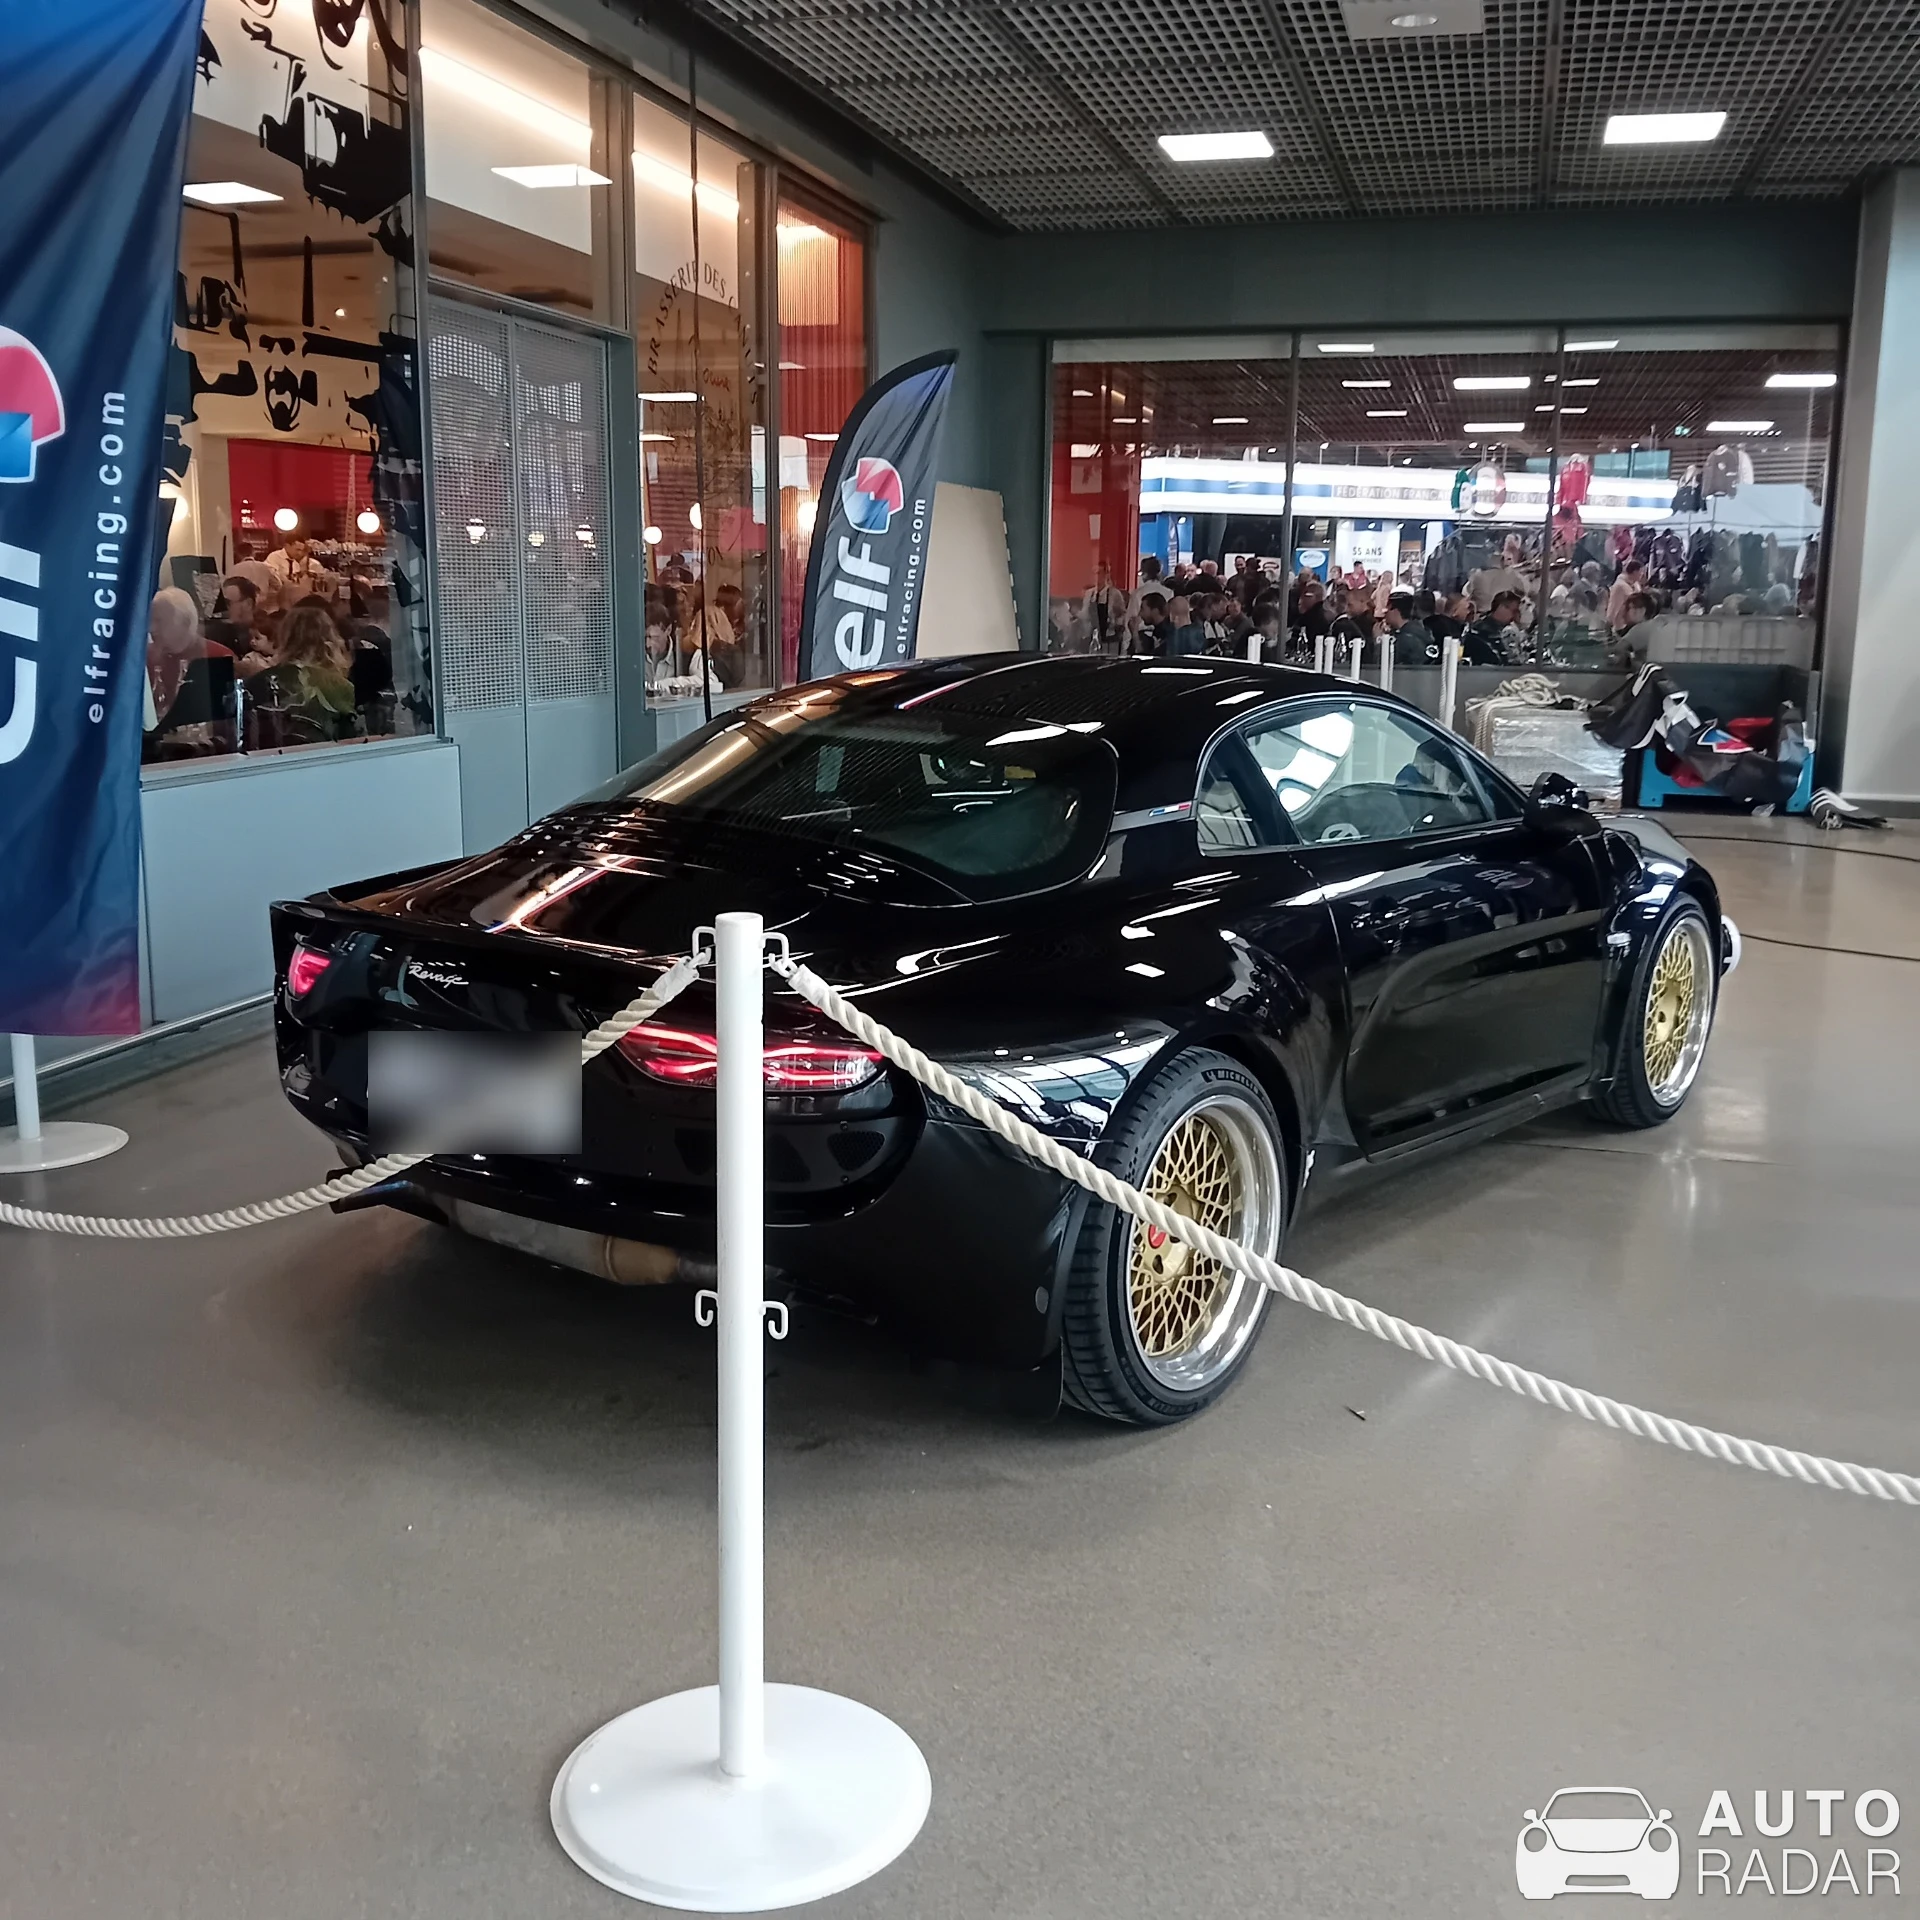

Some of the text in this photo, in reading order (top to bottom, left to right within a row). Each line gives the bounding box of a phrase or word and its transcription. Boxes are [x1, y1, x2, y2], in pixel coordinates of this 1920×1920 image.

[704, 262, 726, 299] DES
[84, 391, 127, 723] elfracing.com
[833, 535, 891, 671] elf
[897, 498, 926, 654] elfracing.com
[1217, 1069, 1259, 1095] MICHELIN
